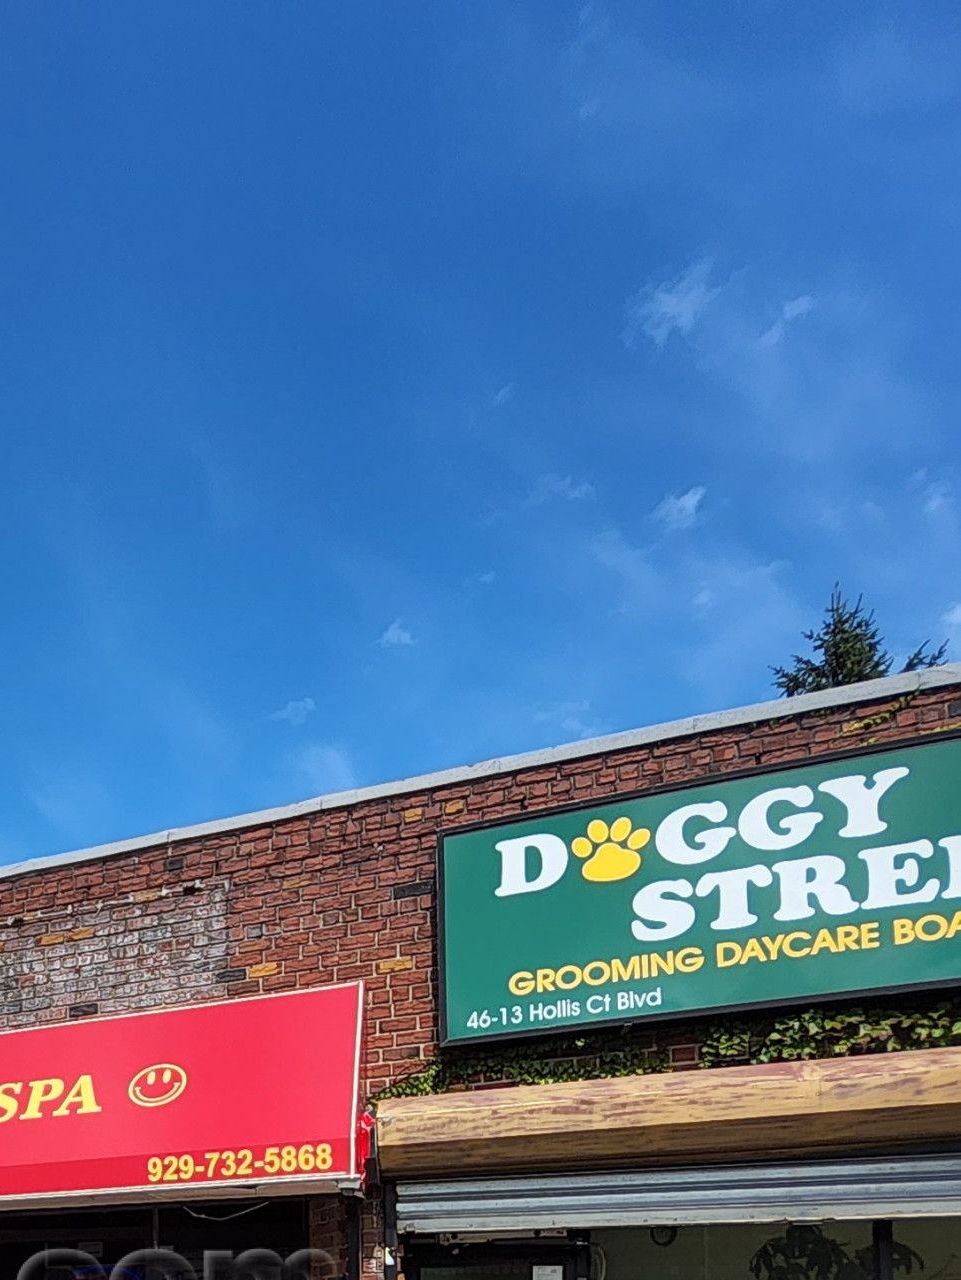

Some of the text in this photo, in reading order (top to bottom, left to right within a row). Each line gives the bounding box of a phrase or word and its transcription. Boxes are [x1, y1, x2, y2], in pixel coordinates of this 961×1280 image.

[494, 766, 909, 897] DGGY
[508, 947, 704, 997] GROOMING
[716, 921, 879, 968] DAYCARE
[466, 986, 662, 1030] 46-13 Hollis Ct Blvd
[147, 1143, 333, 1182] 929-732-5868
